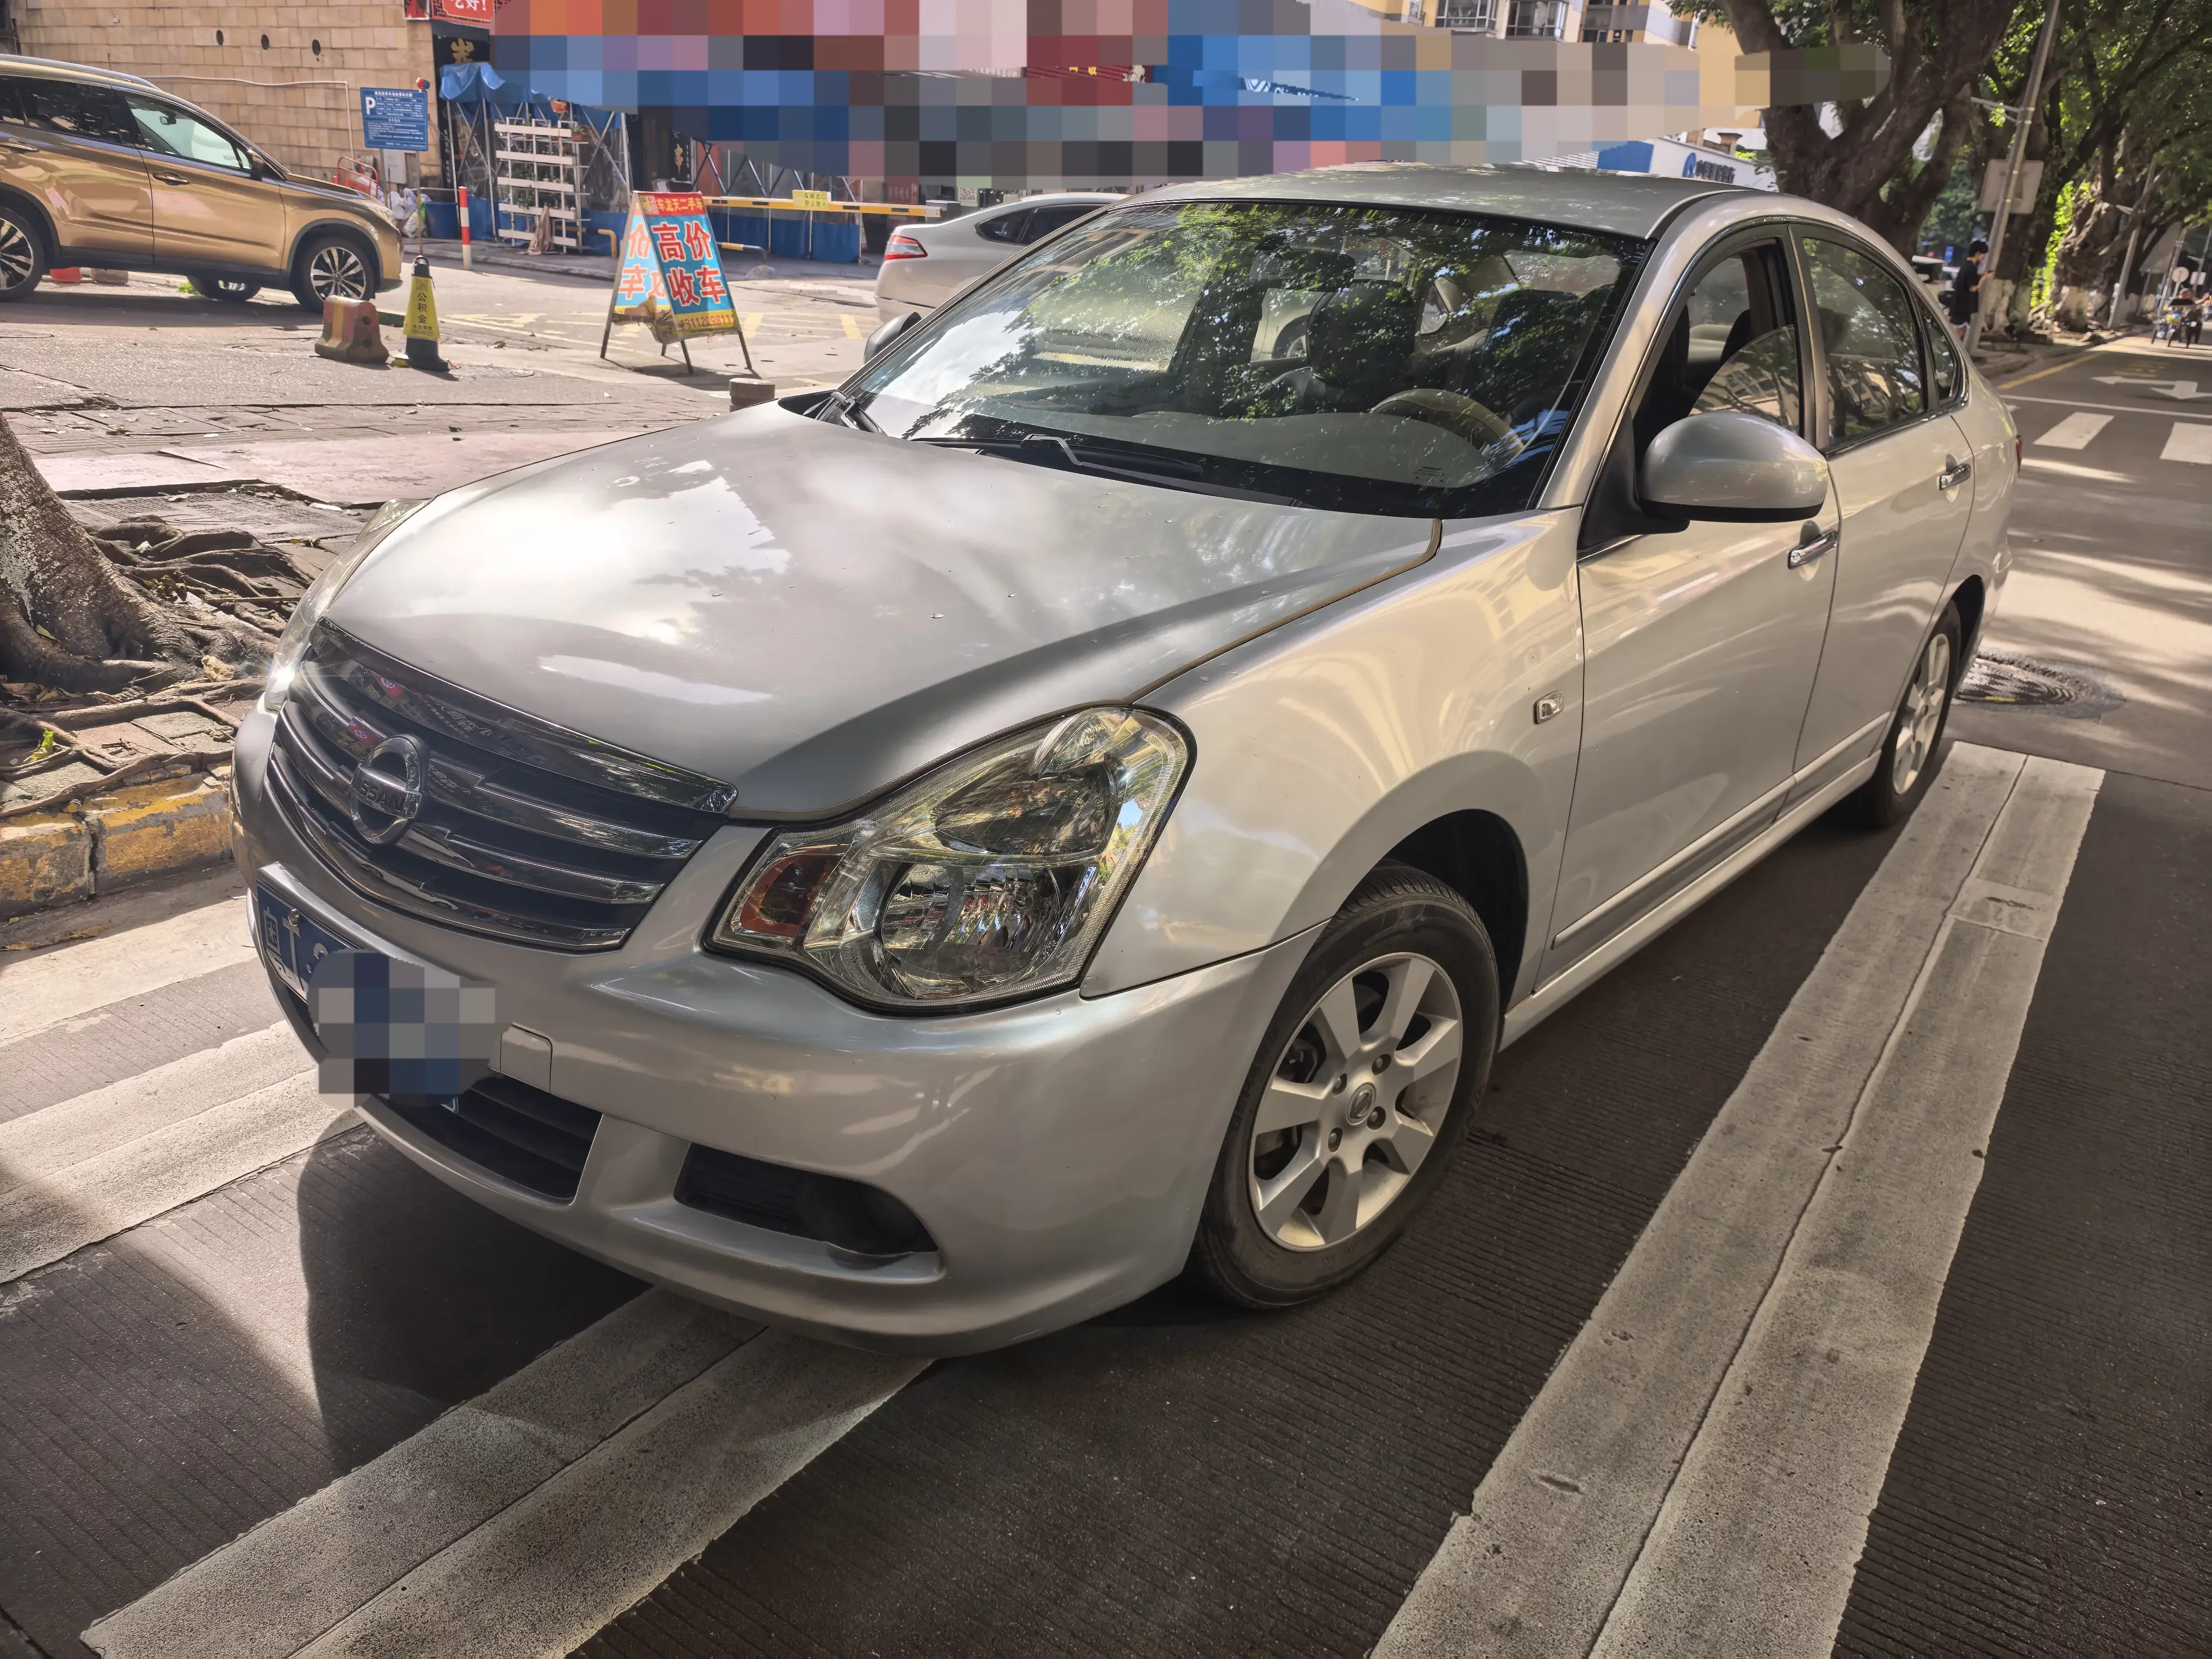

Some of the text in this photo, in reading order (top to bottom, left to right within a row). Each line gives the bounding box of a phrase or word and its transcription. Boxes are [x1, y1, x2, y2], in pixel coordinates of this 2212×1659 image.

[365, 96, 376, 115] P
[650, 220, 713, 262] 高价
[666, 265, 727, 307] 收车
[417, 292, 427, 324] 公积金
